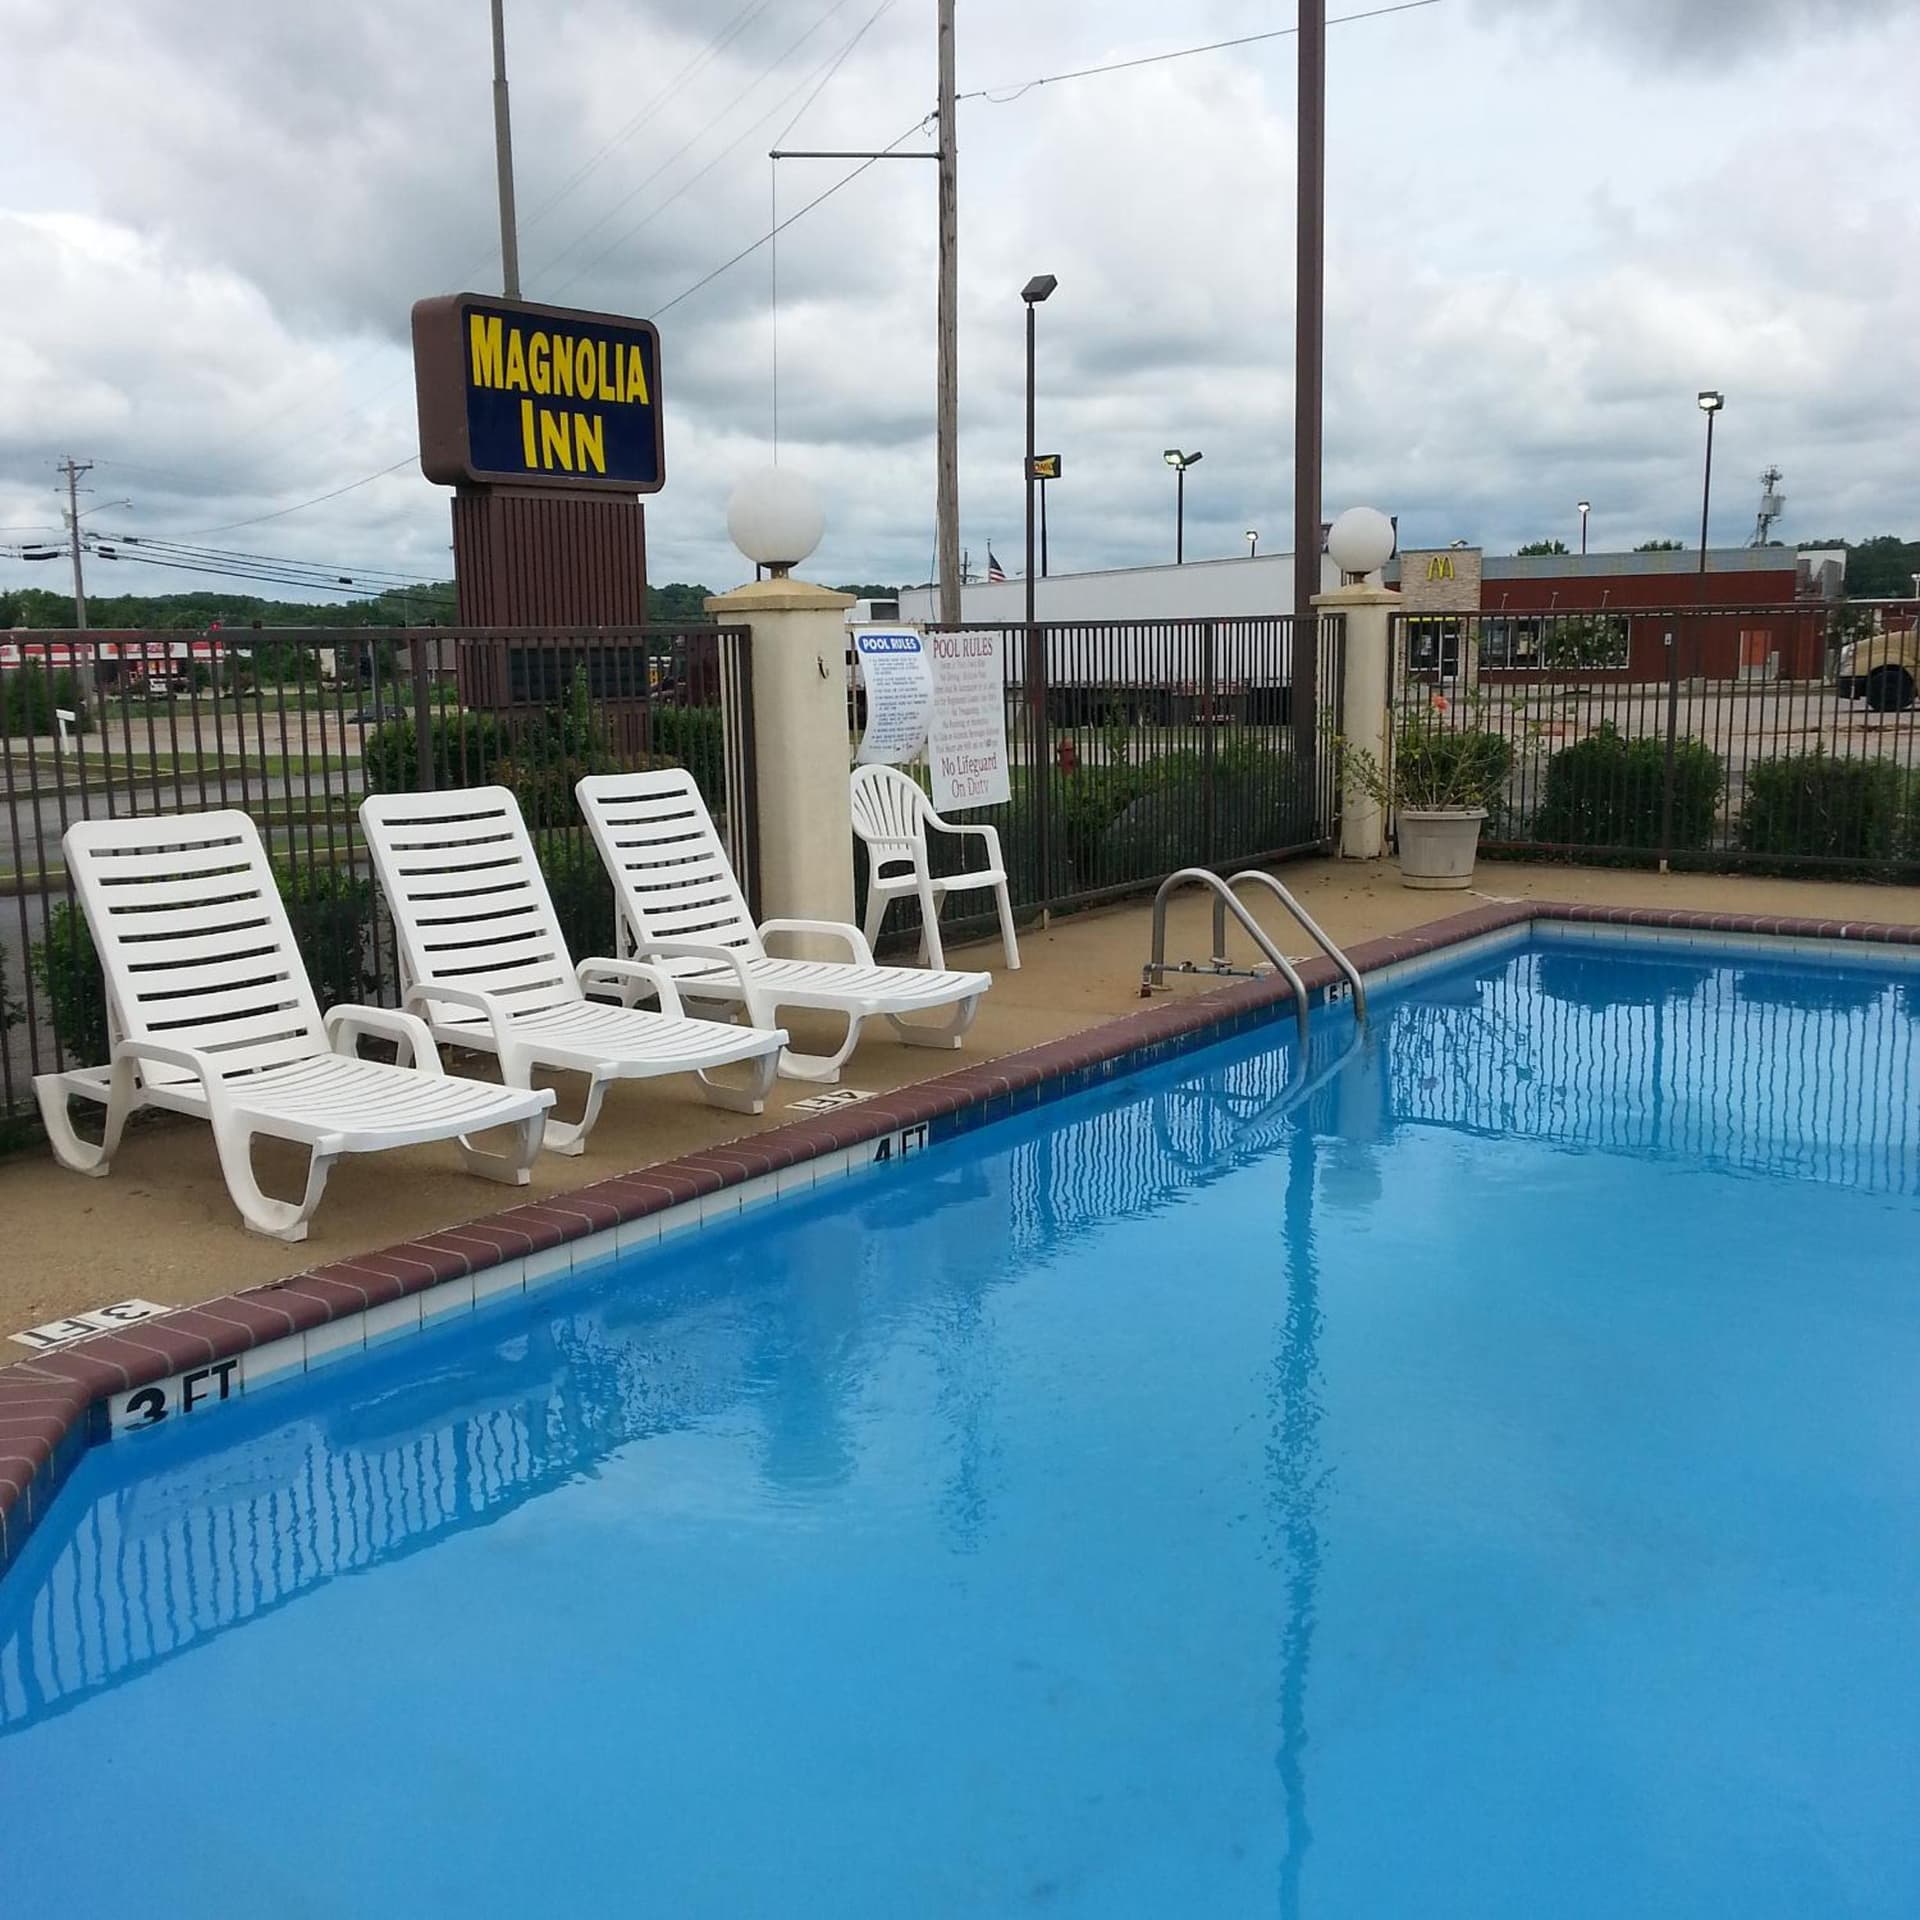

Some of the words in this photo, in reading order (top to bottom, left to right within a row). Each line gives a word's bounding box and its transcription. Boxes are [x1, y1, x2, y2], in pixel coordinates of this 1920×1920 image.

[470, 314, 649, 405] MAGNOLIA
[521, 399, 607, 474] INN
[861, 638, 890, 651] POOL
[890, 637, 917, 650] RULES
[933, 638, 960, 659] POOL
[963, 637, 993, 657] RULES
[941, 757, 956, 777] No
[957, 751, 997, 778] Lifeguard
[951, 778, 966, 799] On
[967, 777, 989, 797] Duty
[873, 1137, 893, 1162] 4
[902, 1124, 927, 1155] FT
[101, 1304, 150, 1320] 3
[23, 1320, 100, 1347] FT
[125, 1387, 168, 1431] 3
[183, 1359, 238, 1413] FT
